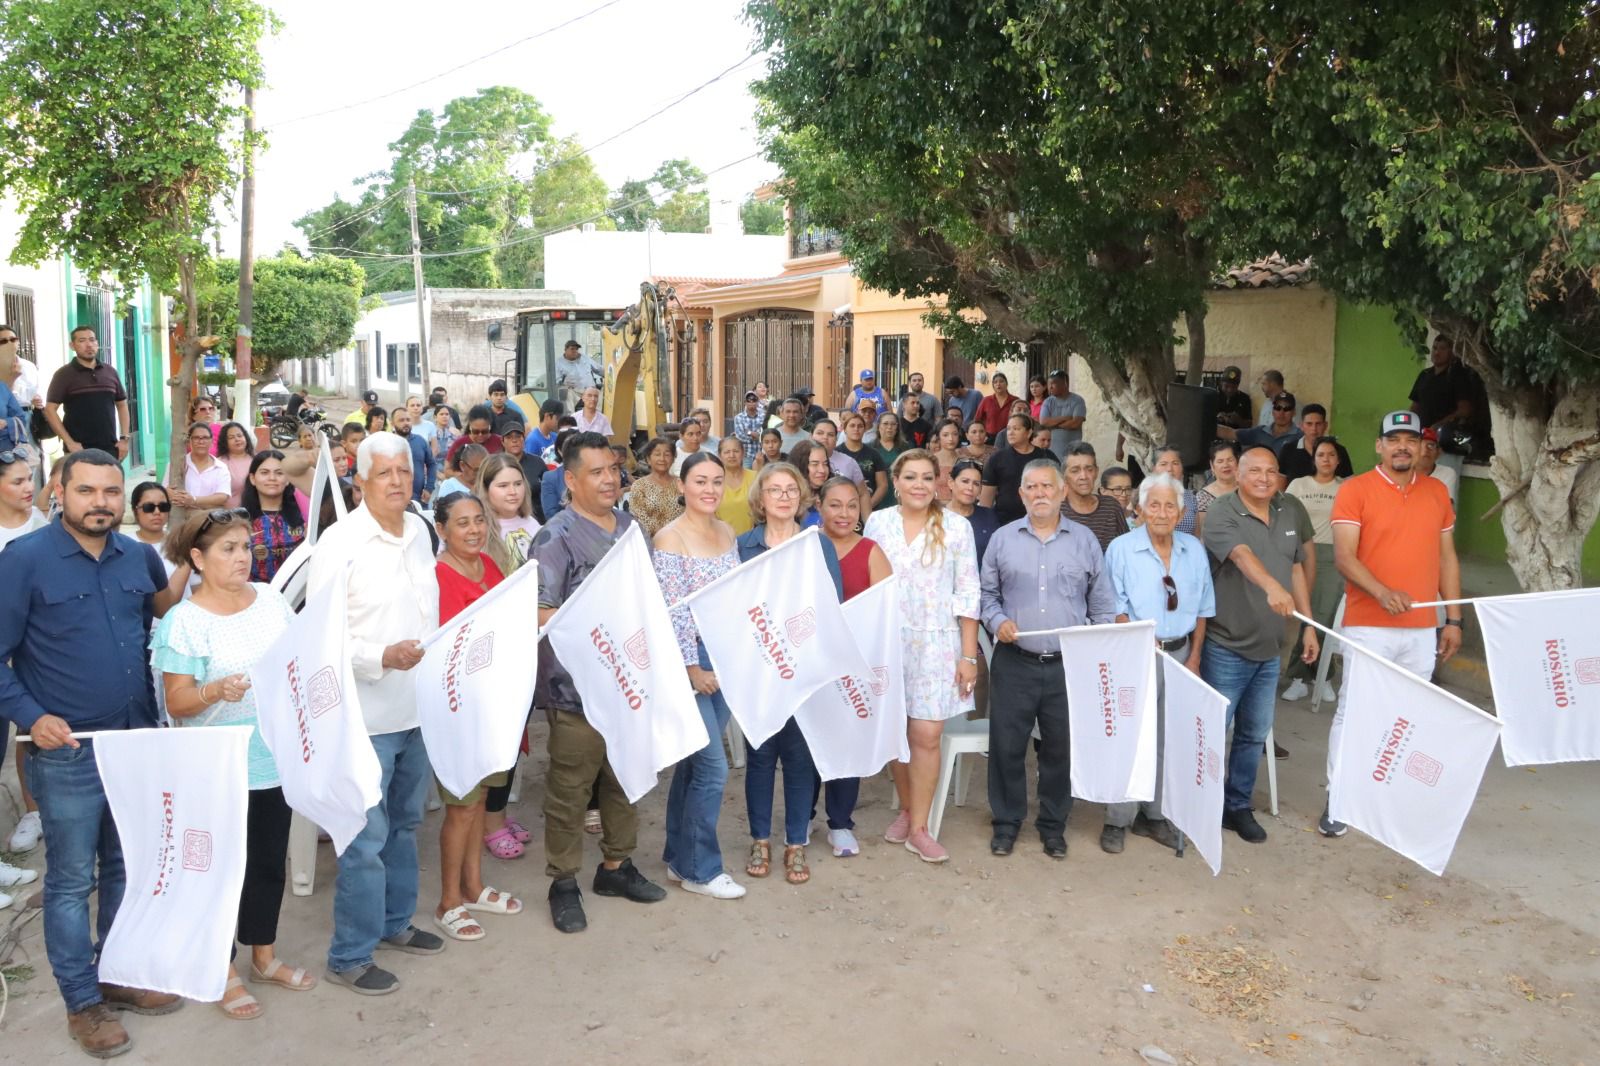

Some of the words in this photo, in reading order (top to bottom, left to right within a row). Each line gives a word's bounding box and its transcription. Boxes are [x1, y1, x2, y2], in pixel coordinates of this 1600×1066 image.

[447, 622, 469, 712] ROSARIO
[590, 627, 642, 710] ROSARIO
[748, 606, 794, 680] ROSARIO
[1545, 640, 1568, 707] ROSARIO
[287, 660, 310, 763] ROSARIO
[840, 675, 868, 718] SARIO
[1099, 662, 1113, 737] ROSARIO
[1372, 717, 1409, 782] ROSARIO
